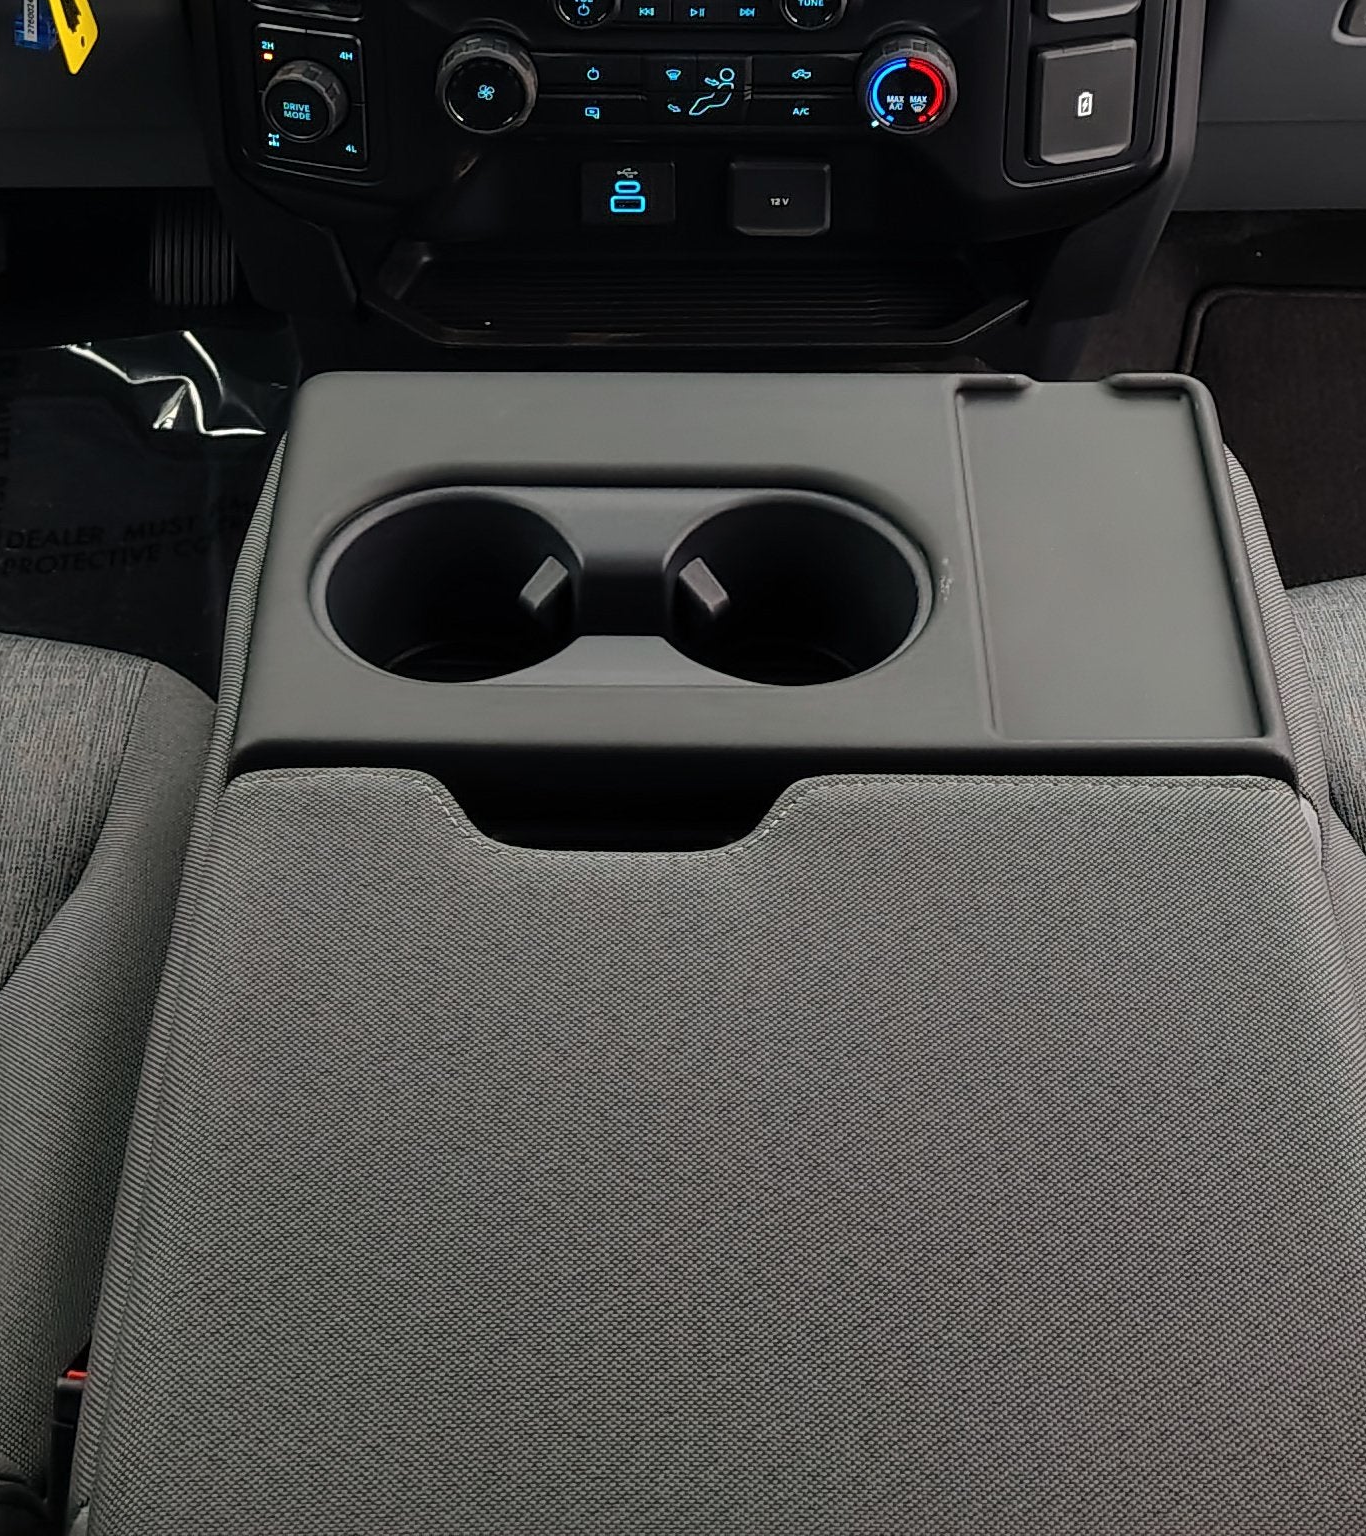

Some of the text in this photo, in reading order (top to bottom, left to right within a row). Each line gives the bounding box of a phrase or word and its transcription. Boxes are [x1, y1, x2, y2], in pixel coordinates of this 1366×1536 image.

[261, 41, 275, 50] 2H
[339, 51, 353, 60] 4H
[886, 95, 904, 103] MAX
[909, 95, 928, 103] MAX
[283, 101, 310, 112] DRIVE
[792, 106, 810, 116] A/C
[889, 103, 903, 111] A/C
[284, 110, 311, 120] MODE
[345, 144, 357, 153] 4L
[771, 197, 790, 206] 12 V
[5, 514, 200, 550] DEALER MUST
[2, 543, 163, 576] PROTECTIVE
